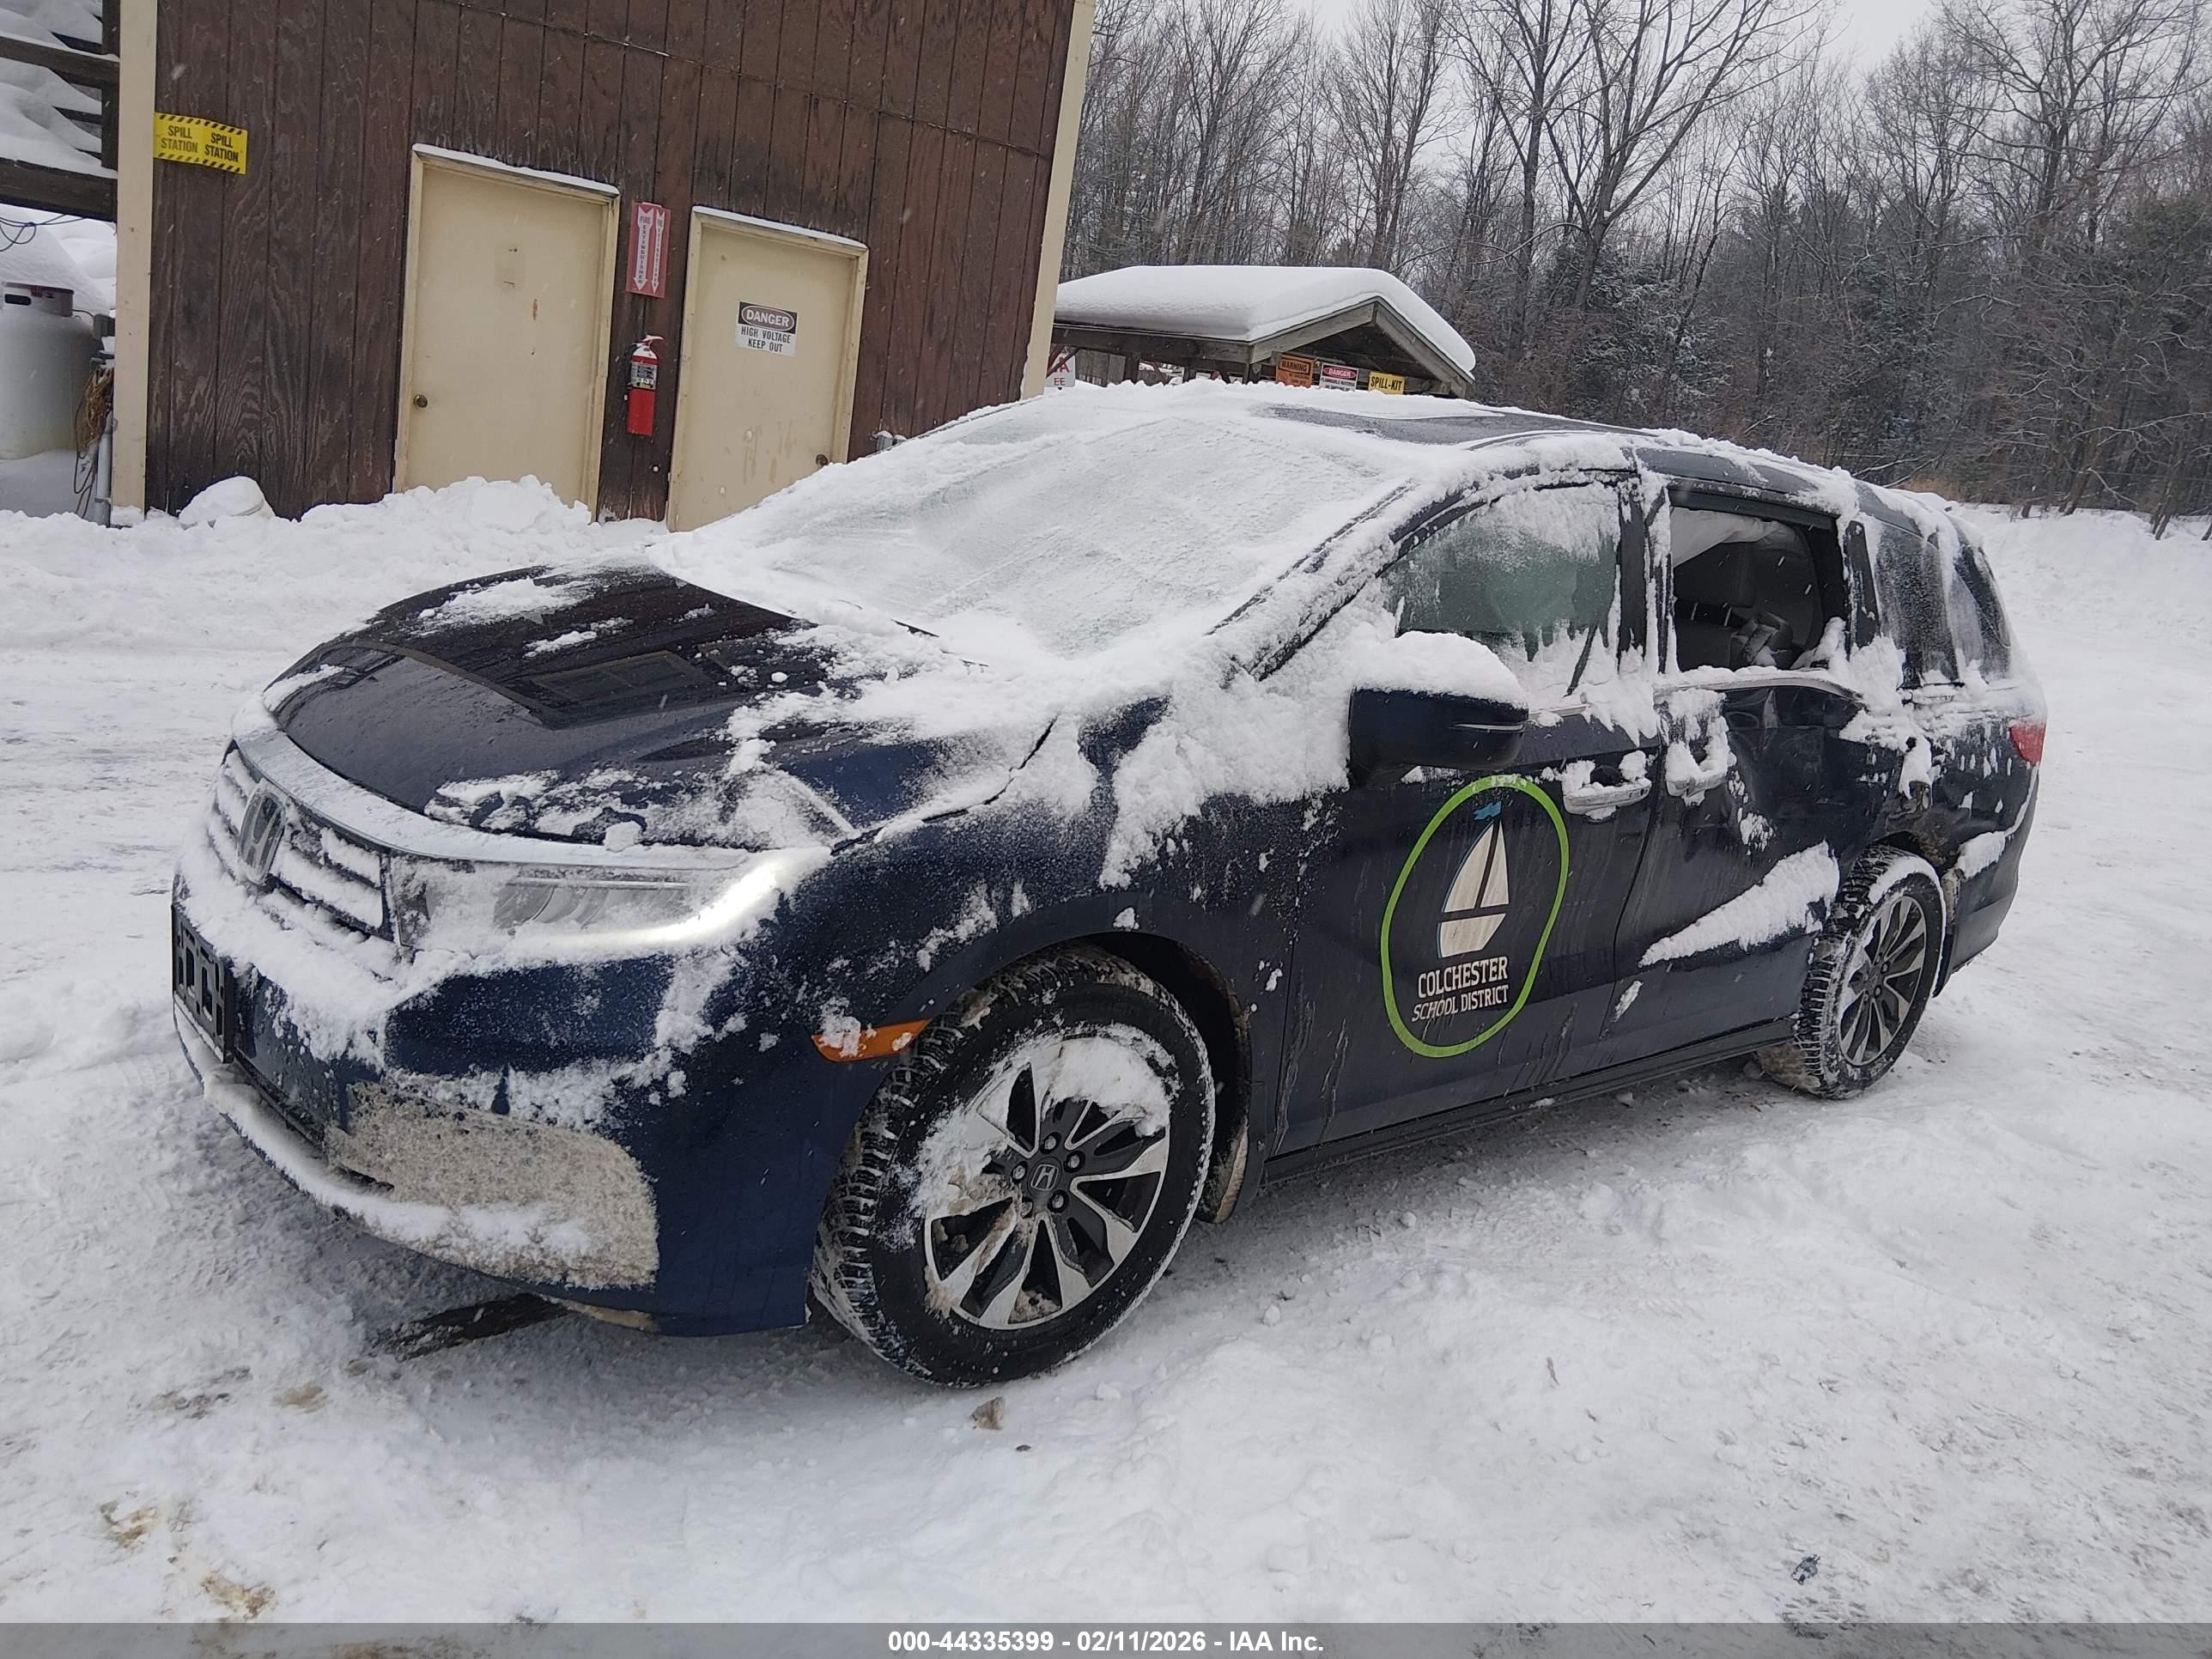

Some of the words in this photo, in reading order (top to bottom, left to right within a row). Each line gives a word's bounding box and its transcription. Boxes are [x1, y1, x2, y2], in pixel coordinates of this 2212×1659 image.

[167, 125, 192, 139] SPILL
[210, 131, 234, 149] SPILL
[161, 137, 198, 154] STATION
[204, 143, 239, 163] STATION
[746, 309, 790, 327] DANGER
[741, 325, 759, 337] HIGH
[762, 330, 791, 344] VOLTAGE
[748, 337, 766, 349] KEEP
[769, 342, 783, 352] OUT
[1281, 360, 1307, 372] WARNING
[1328, 368, 1351, 378] DANGER
[1370, 376, 1403, 391] SPILL-KIT
[1418, 956, 1508, 998] COLCHESTER
[1411, 996, 1459, 1022] SCHOOL
[1461, 984, 1509, 1012] DISTRICT
